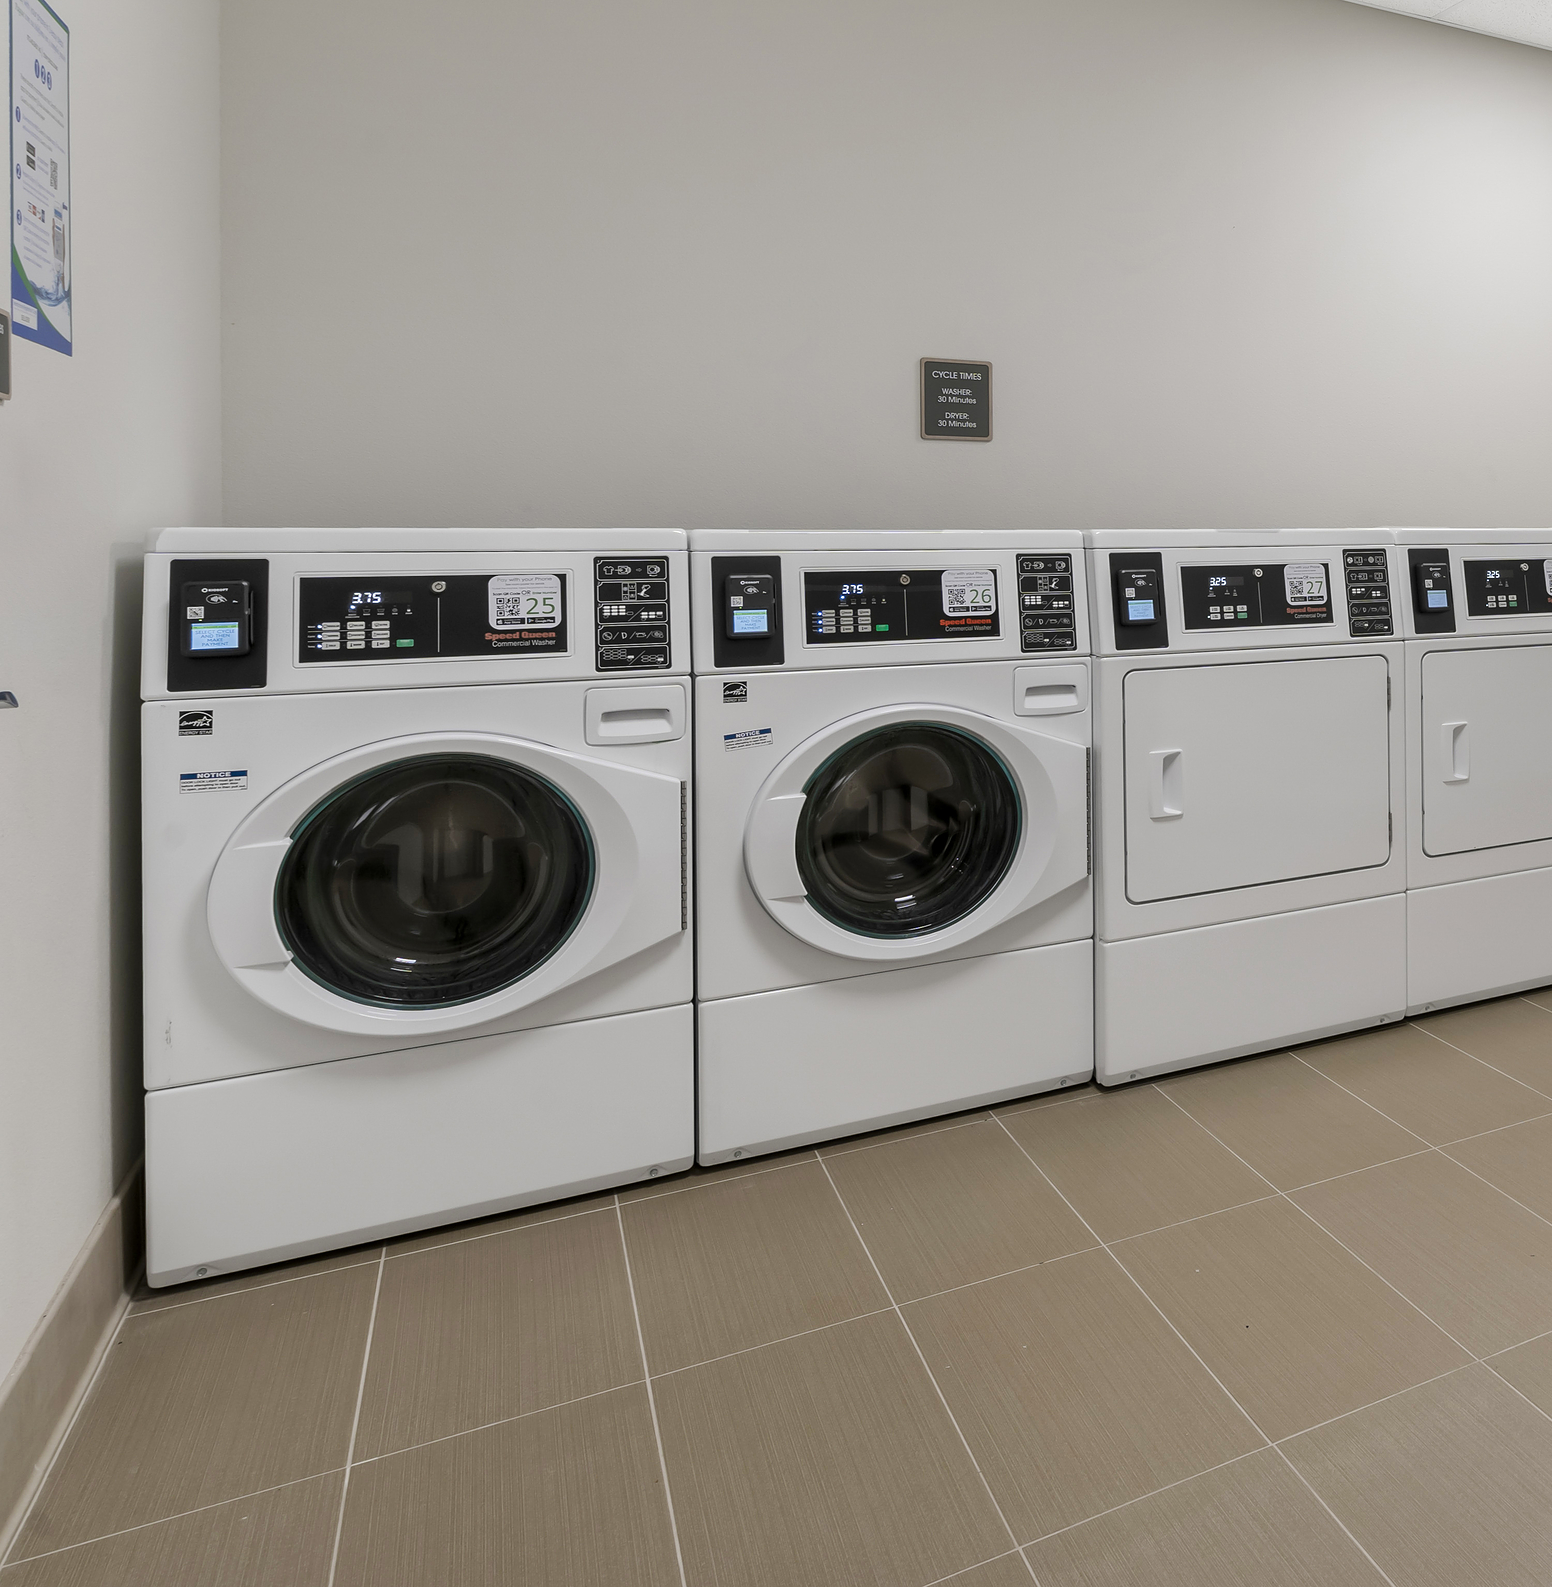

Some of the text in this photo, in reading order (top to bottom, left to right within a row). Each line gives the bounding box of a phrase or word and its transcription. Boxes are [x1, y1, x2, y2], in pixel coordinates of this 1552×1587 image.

[932, 370, 982, 381] CYCLE TIMES
[941, 388, 972, 396] WASHER:
[948, 396, 977, 404] Minutes
[945, 412, 969, 420] DRYER:
[948, 420, 977, 428] Minutes
[1209, 577, 1227, 586] 3.25
[842, 584, 864, 594] 3.75
[1306, 581, 1323, 595] 27
[352, 592, 381, 604] 3.75
[969, 588, 992, 604] 26
[526, 597, 555, 615] 25
[1286, 606, 1307, 614] Speed
[940, 618, 966, 627] Speed
[484, 631, 556, 641] Speed Queen
[492, 639, 530, 648] Commercial
[735, 730, 761, 738] NOTICE
[196, 771, 232, 779] NOTICE
